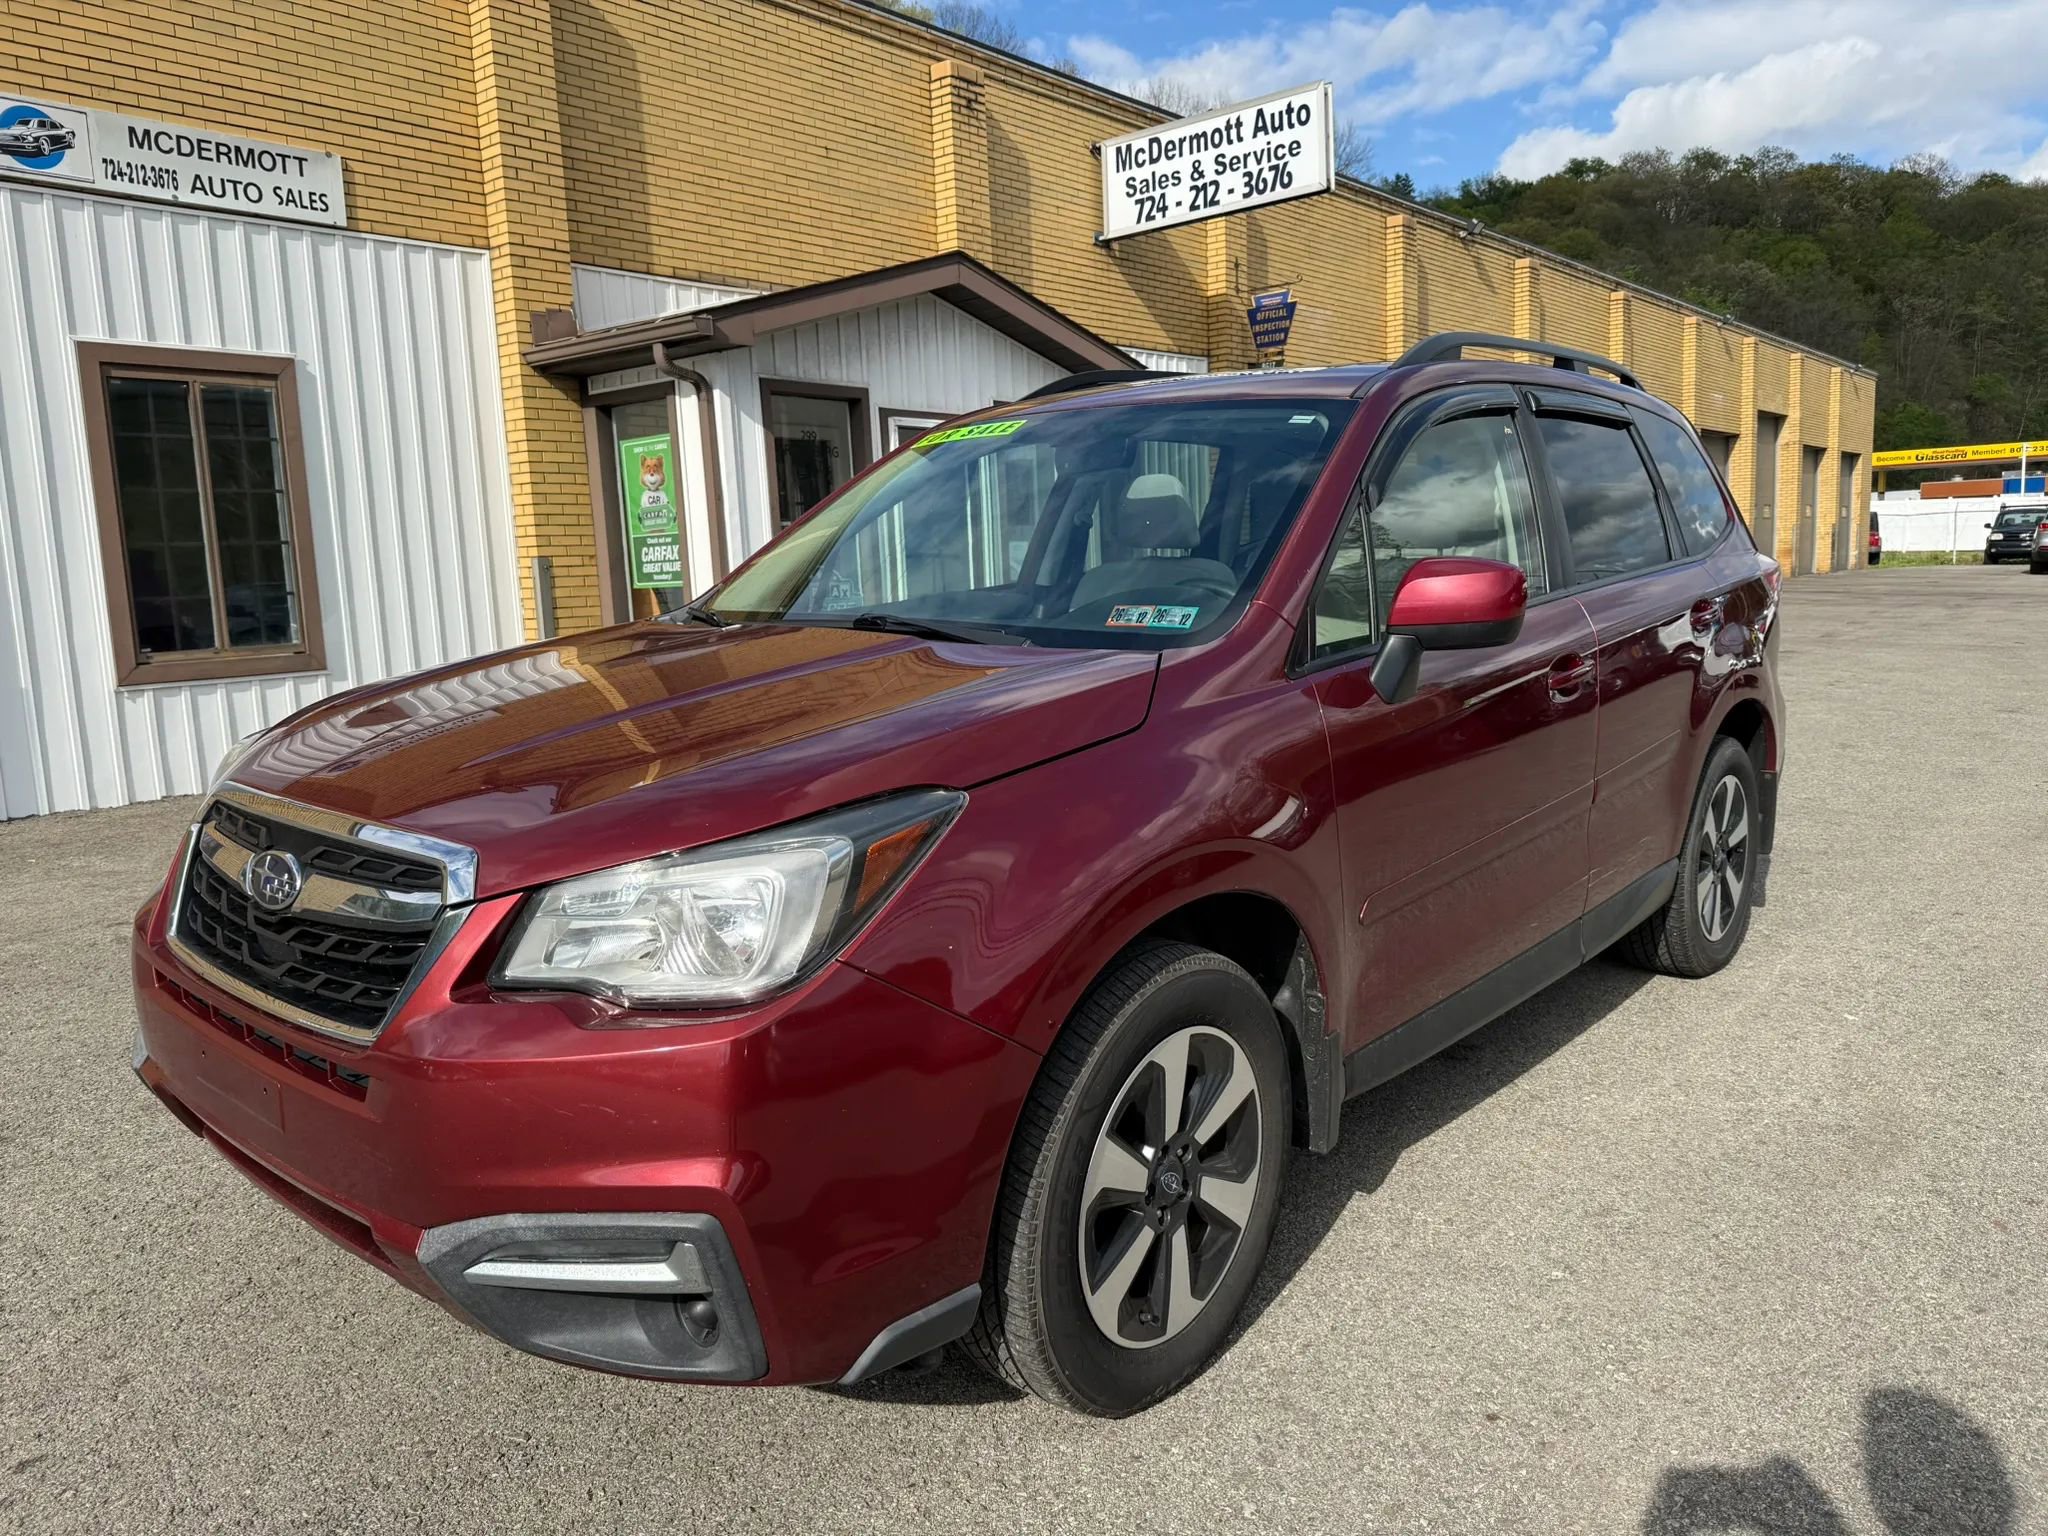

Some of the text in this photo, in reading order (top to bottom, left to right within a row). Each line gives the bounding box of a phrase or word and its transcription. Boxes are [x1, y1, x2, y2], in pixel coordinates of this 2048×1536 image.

[1115, 100, 1311, 174] McDermott Auto
[127, 125, 308, 178] MCDERMOTT
[101, 158, 179, 191] 724-212-3676
[1125, 139, 1302, 198] Sales & Service
[190, 173, 329, 212] AUTO SALES
[1134, 192, 1168, 225] 724
[1189, 180, 1220, 212] 212
[1242, 161, 1293, 199] 3676
[1256, 308, 1288, 321] OFFICIAL
[1252, 319, 1291, 333] INSPECTION
[1256, 332, 1285, 344] STATION
[959, 421, 1025, 438] SALE
[1915, 451, 1968, 462] Glasscard
[641, 545, 680, 562] CARFAX
[643, 561, 682, 573] GREAT VALUE
[1110, 607, 1126, 622] 26
[1135, 611, 1148, 624] 12
[1178, 613, 1192, 626] 12
